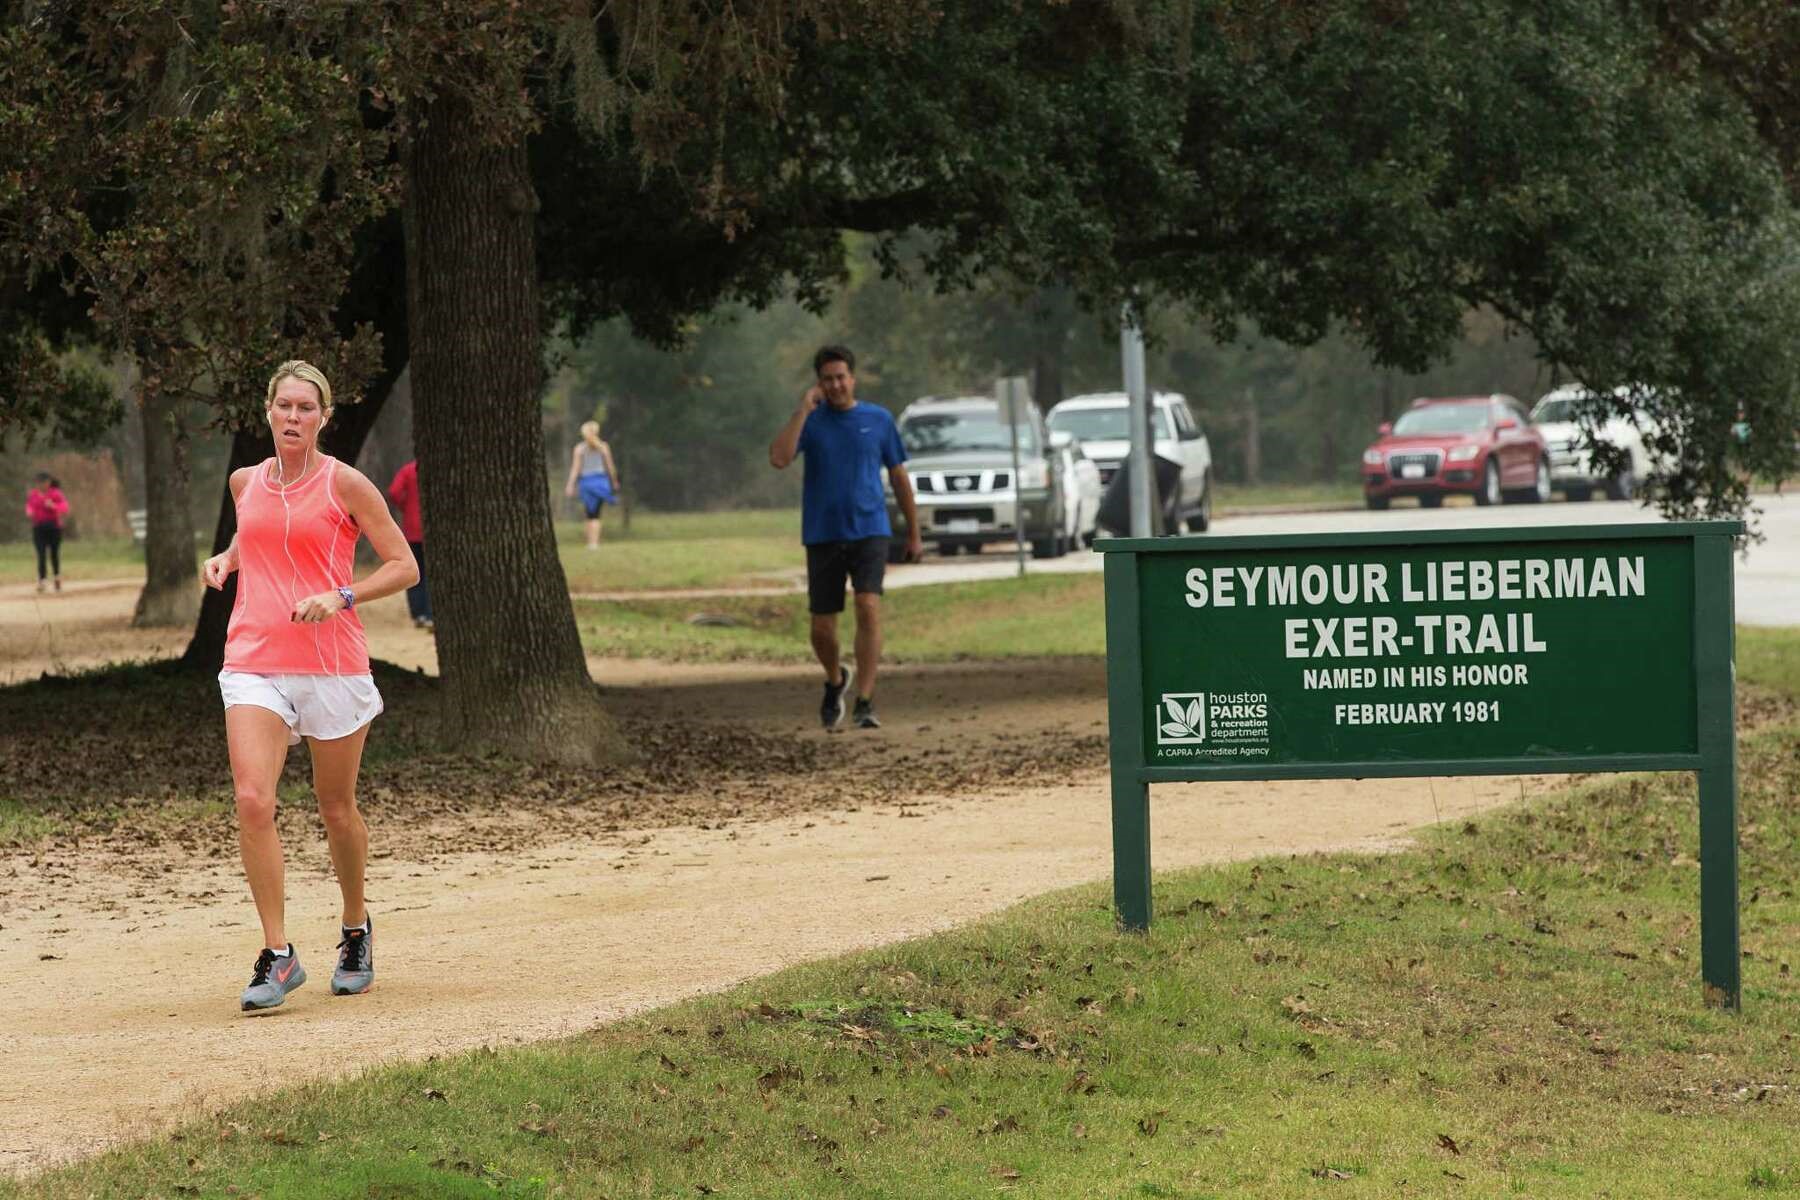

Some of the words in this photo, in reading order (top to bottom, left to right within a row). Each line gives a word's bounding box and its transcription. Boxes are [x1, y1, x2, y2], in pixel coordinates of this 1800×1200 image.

[1186, 564, 1389, 607] SEYMOUR
[1402, 557, 1645, 601] LIEBERMAN
[1285, 613, 1546, 658] EXER-TRAIL
[1304, 668, 1376, 689] NAMED
[1384, 667, 1404, 688] IN
[1411, 666, 1446, 687] HIS
[1453, 664, 1528, 686] HONOR
[1209, 692, 1268, 704] houston
[1210, 704, 1268, 719] PARKS
[1336, 703, 1445, 724] FEBRUARY
[1453, 701, 1499, 722] 1981
[1211, 720, 1218, 728] &
[1221, 719, 1268, 728] recreation
[1211, 728, 1268, 738] department
[1157, 748, 1164, 757] A
[1166, 748, 1193, 757] CAPRA
[1240, 747, 1269, 756] Agency
